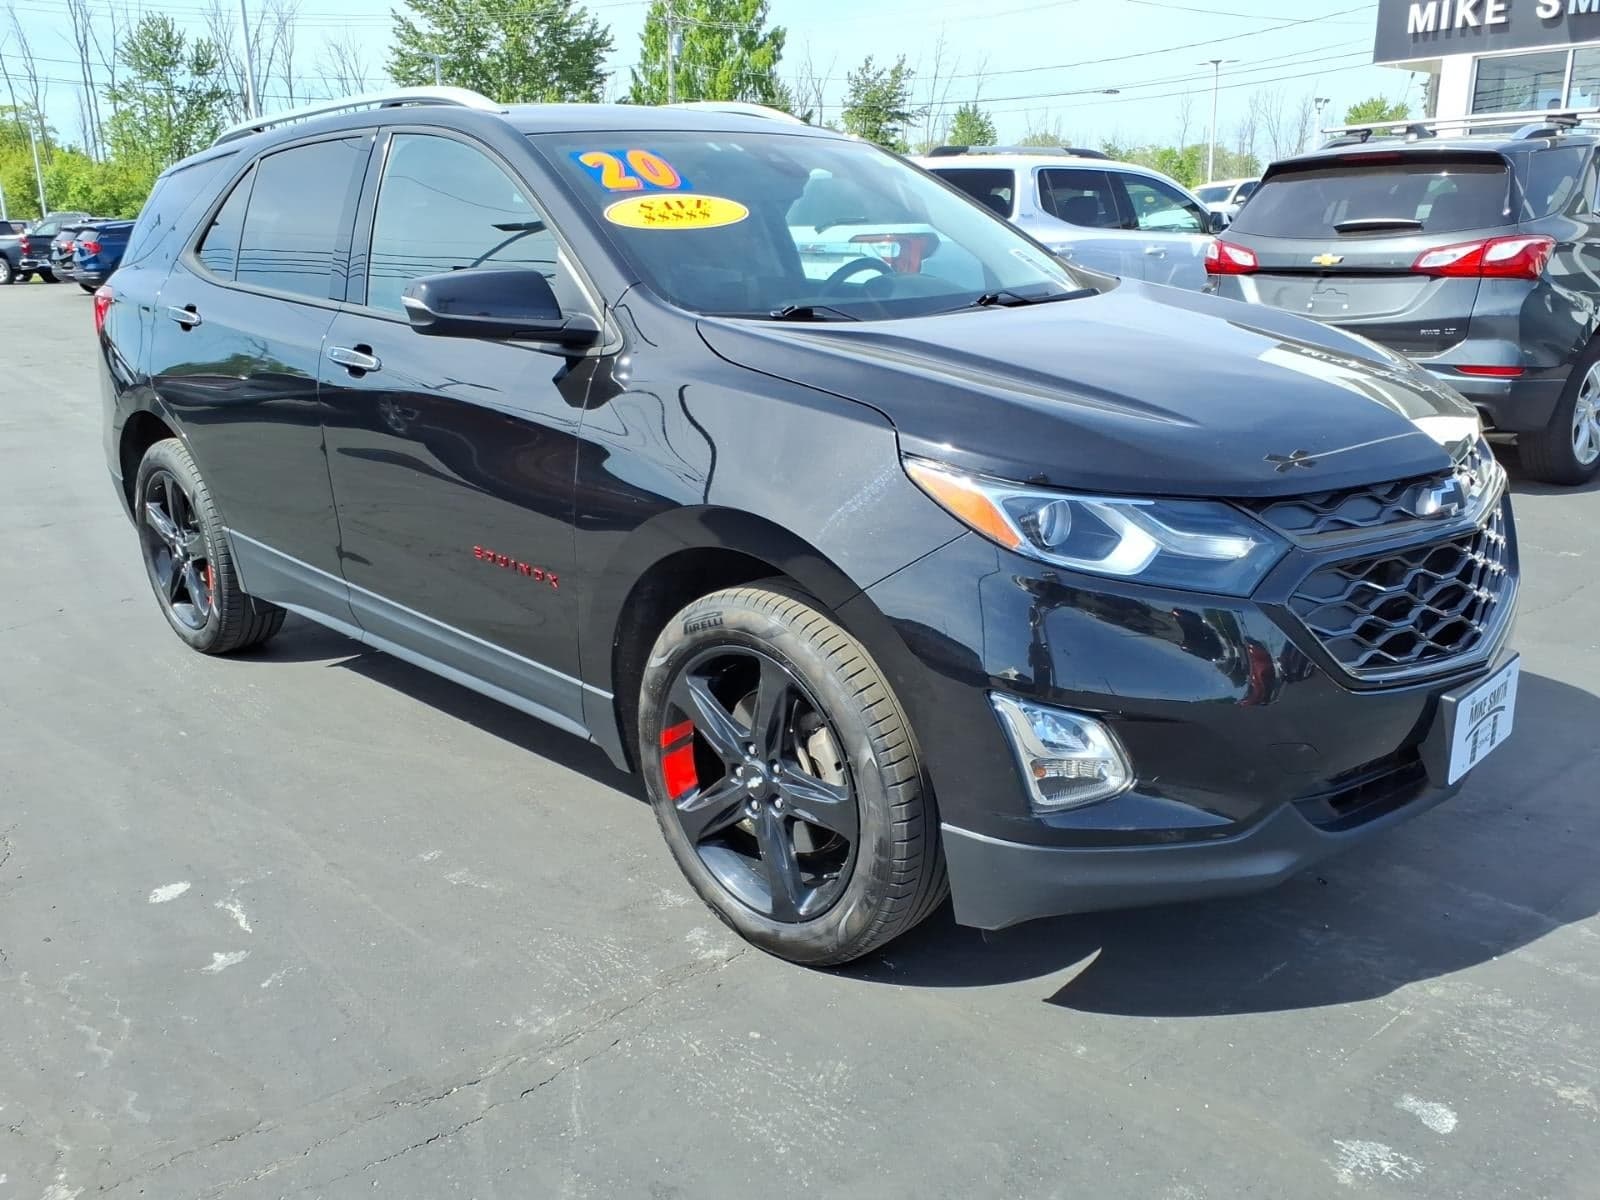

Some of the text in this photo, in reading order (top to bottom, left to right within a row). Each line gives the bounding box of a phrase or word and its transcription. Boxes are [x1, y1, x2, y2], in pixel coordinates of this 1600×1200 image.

[1407, 0, 1507, 34] MIKE
[578, 149, 682, 191] 20
[684, 611, 724, 636] PIRELLI
